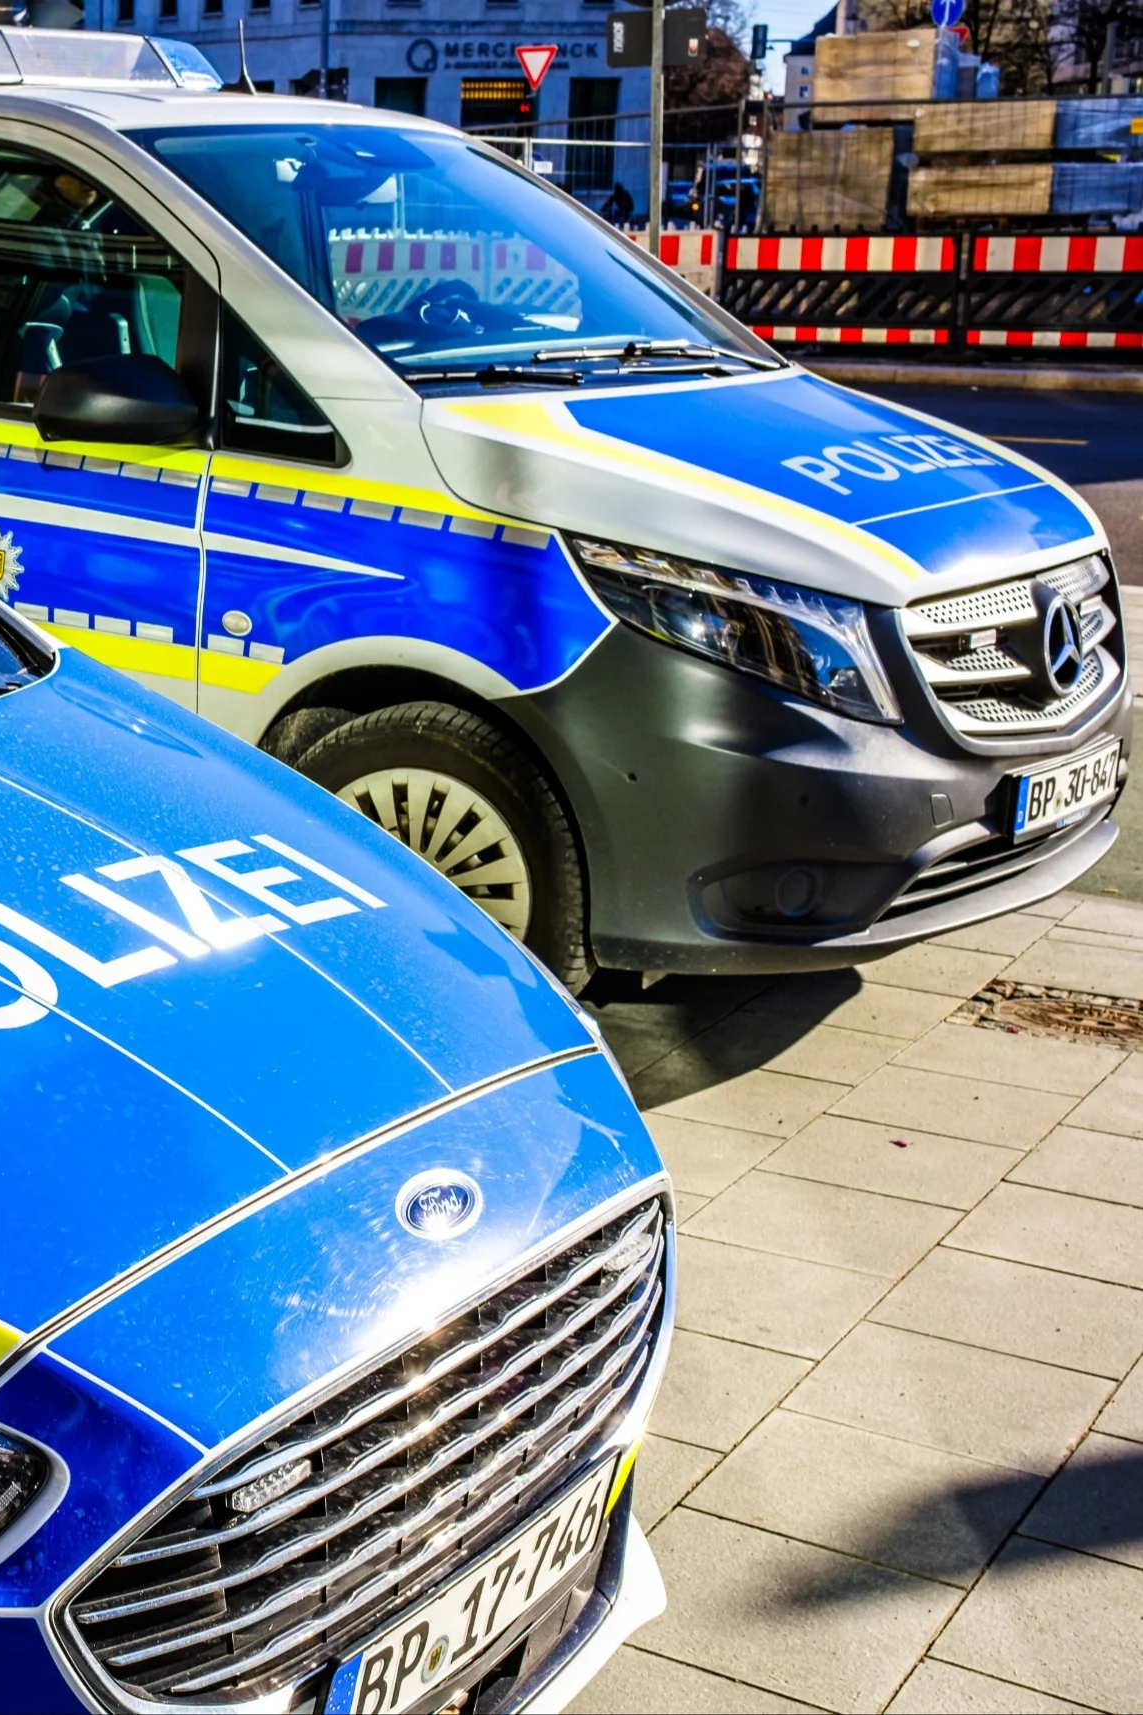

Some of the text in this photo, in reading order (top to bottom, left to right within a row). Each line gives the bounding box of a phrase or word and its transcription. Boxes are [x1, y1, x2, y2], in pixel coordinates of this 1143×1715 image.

[779, 434, 1005, 496] POLIZEI
[1027, 776, 1056, 822] BP
[1064, 749, 1118, 808] 30-847
[418, 1187, 462, 1217] Ford
[356, 1479, 603, 1715] BP 17-746
